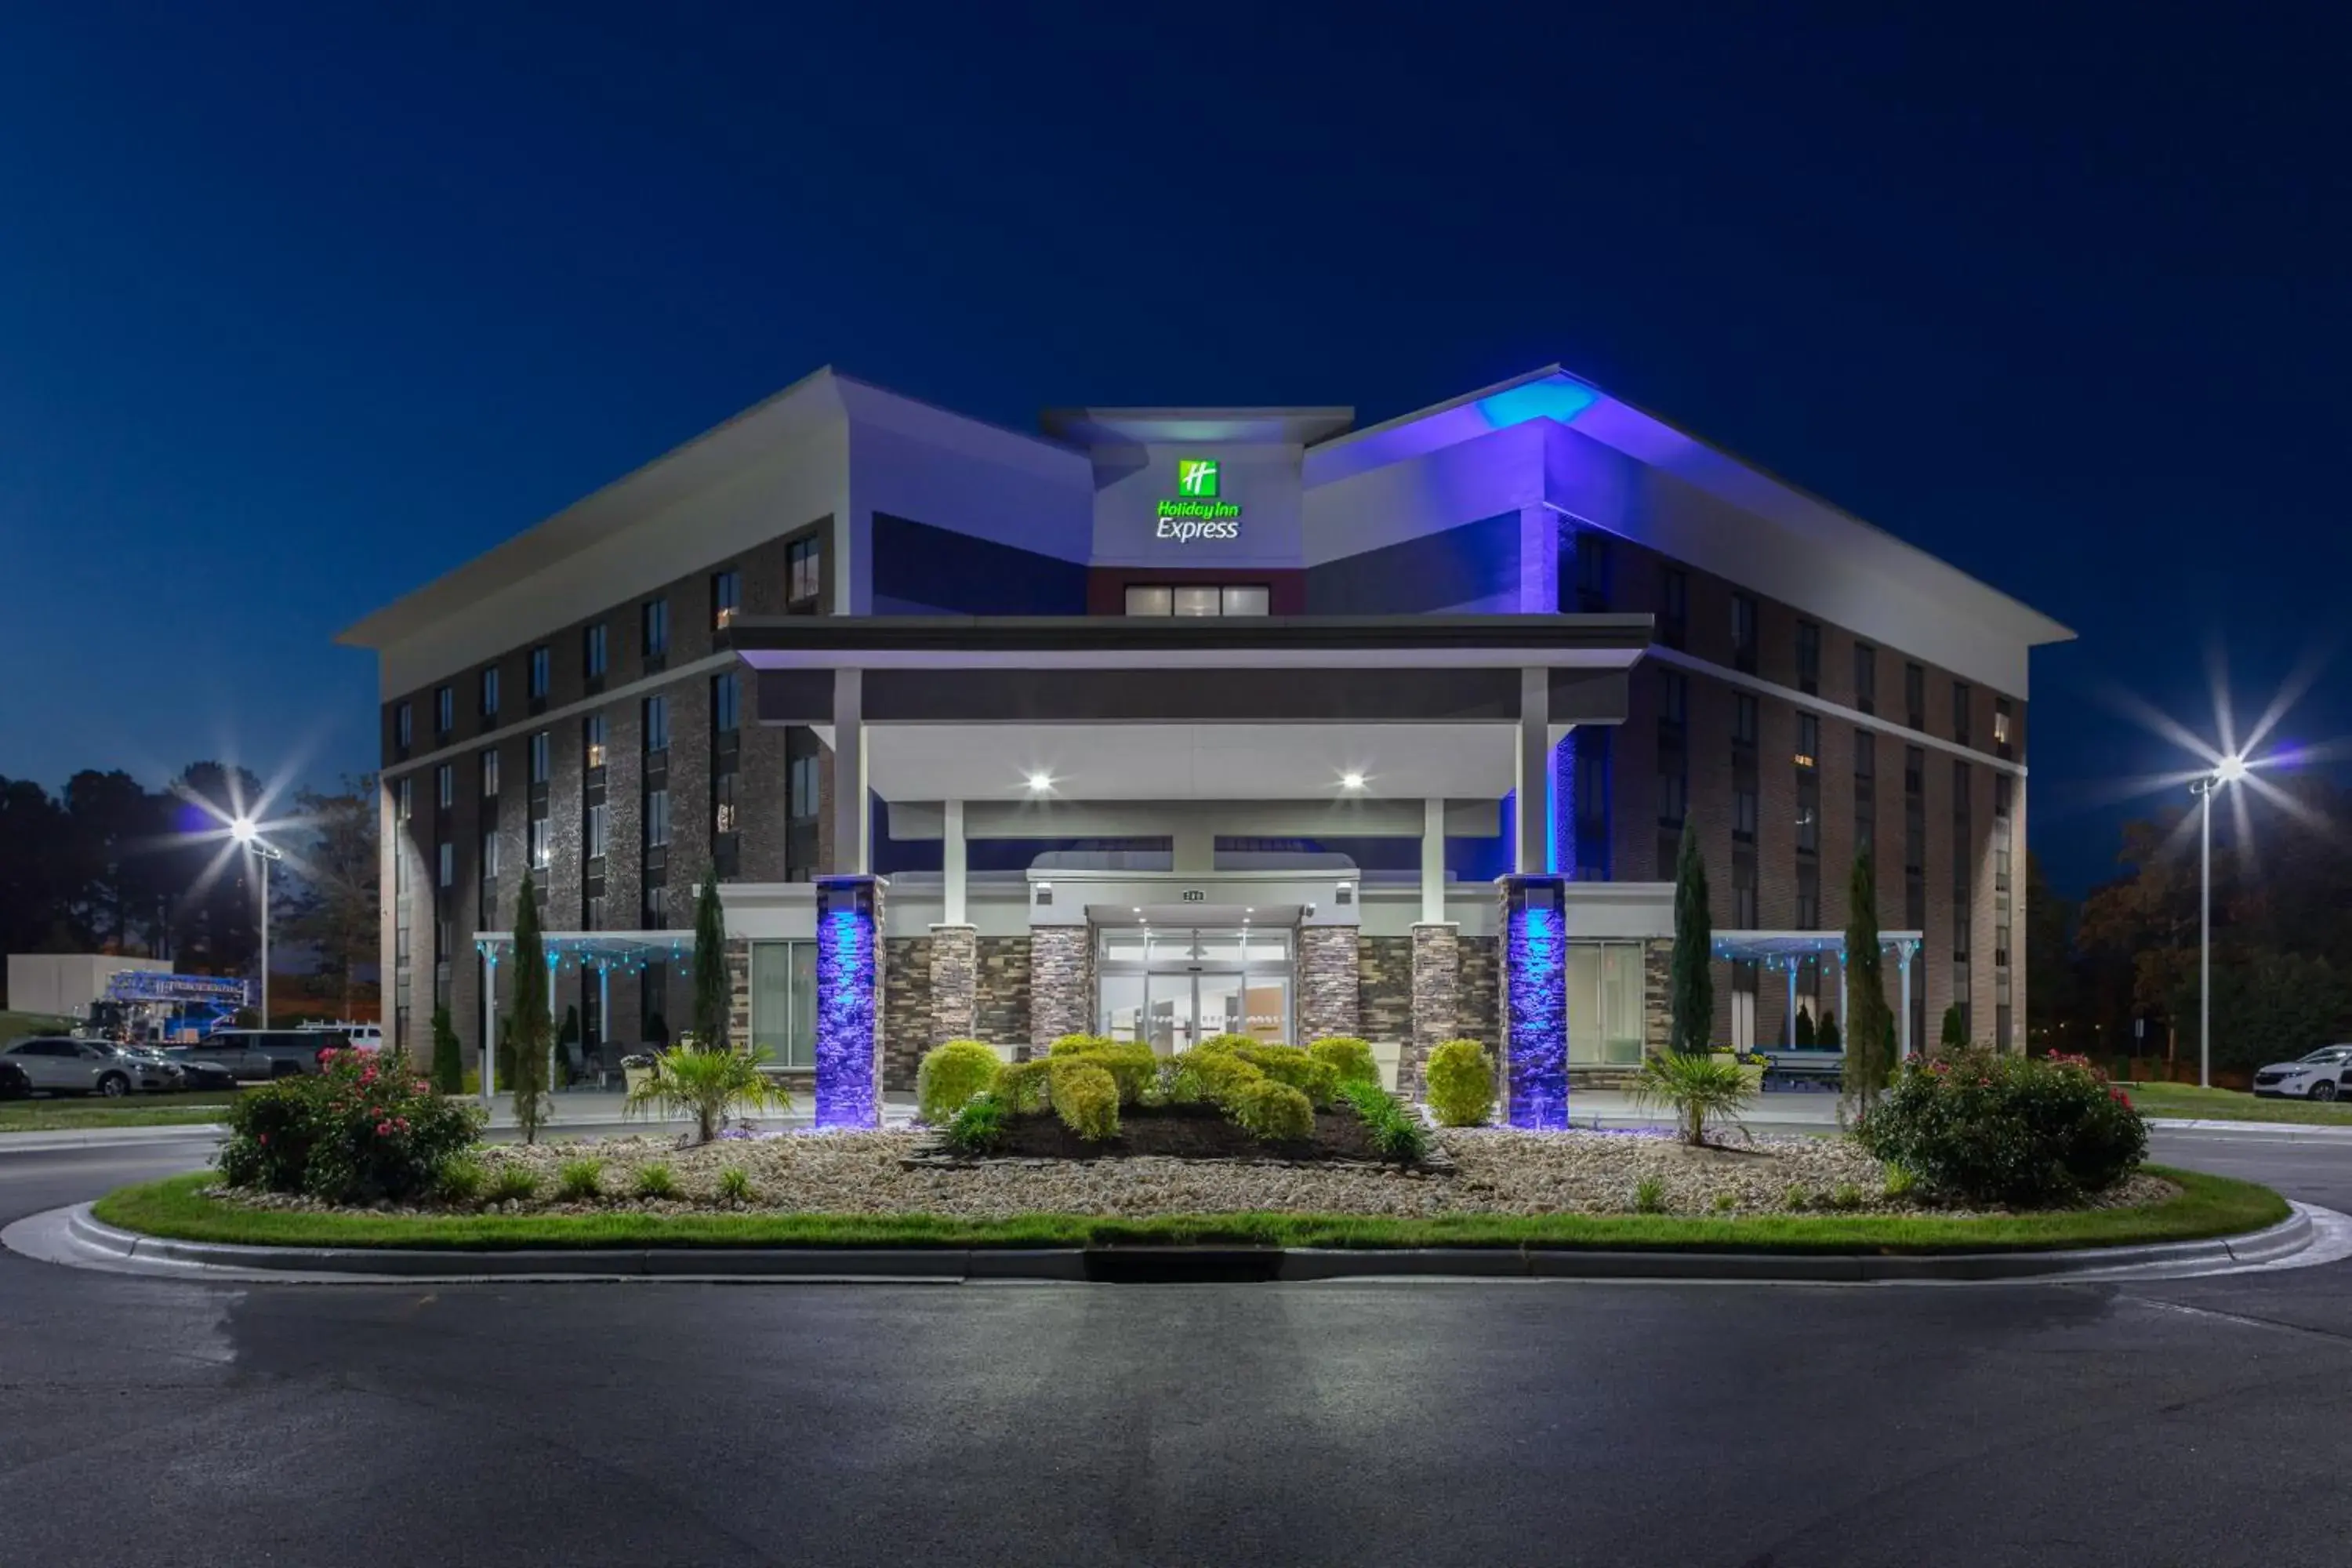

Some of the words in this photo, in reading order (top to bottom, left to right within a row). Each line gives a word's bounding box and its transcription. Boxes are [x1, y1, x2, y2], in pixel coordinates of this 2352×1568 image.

[1158, 501, 1214, 519] Holiday
[1215, 501, 1239, 517] Inn
[1156, 517, 1239, 543] Express
